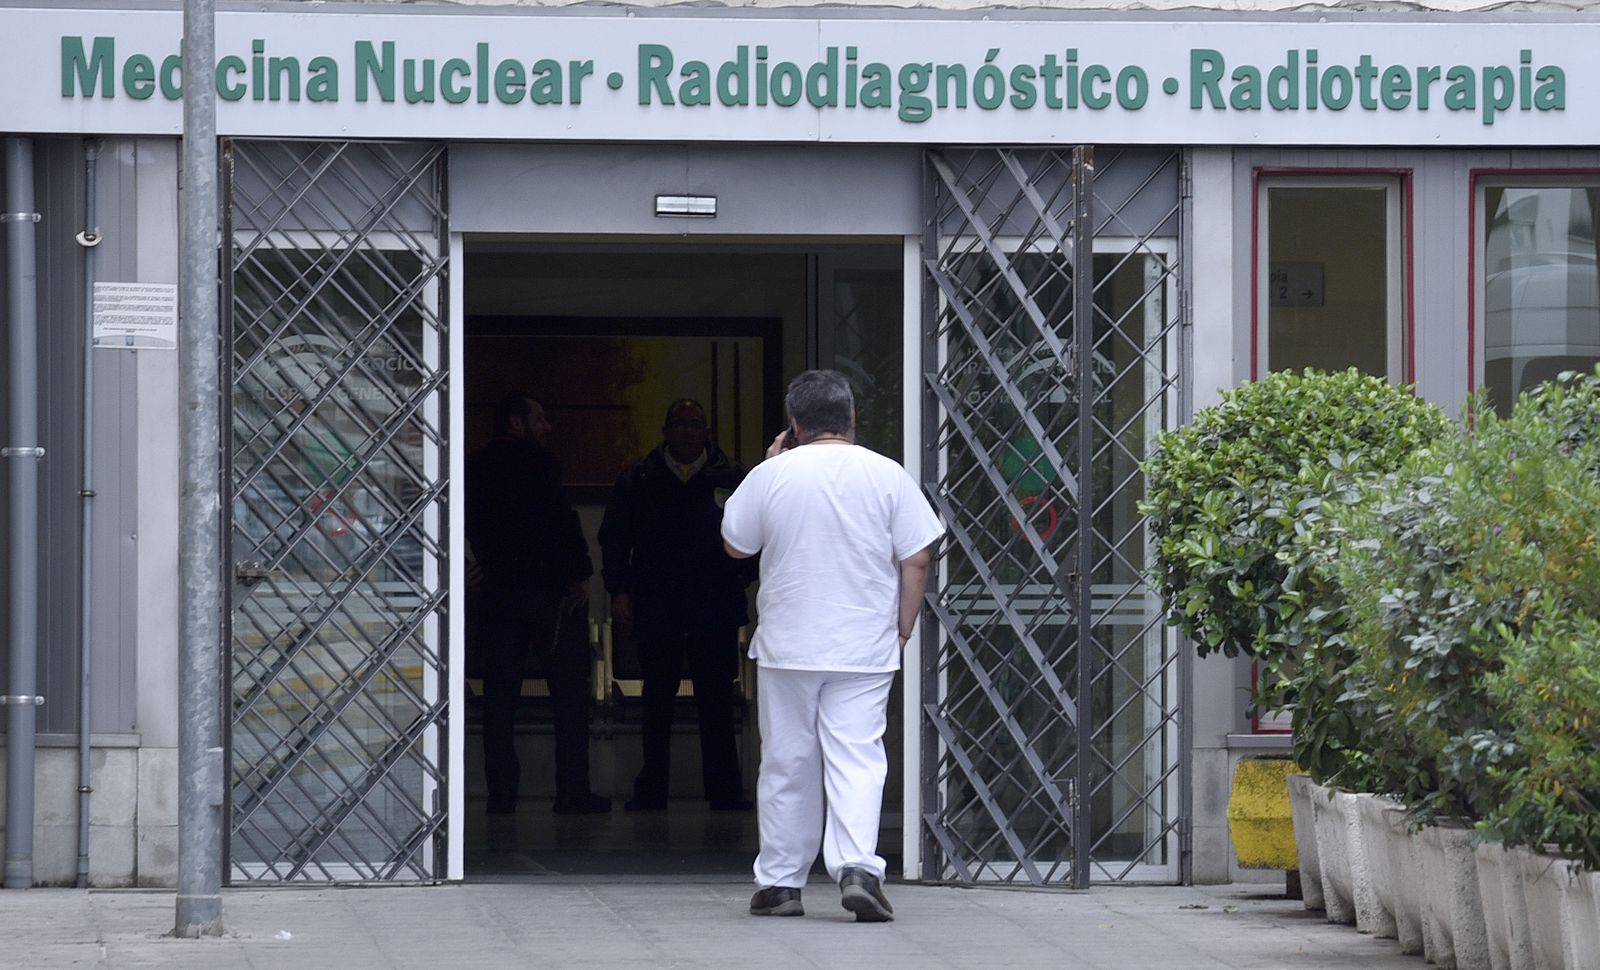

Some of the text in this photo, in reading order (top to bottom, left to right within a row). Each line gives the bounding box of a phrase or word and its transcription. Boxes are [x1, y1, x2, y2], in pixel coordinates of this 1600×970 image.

[62, 37, 1566, 124] Medcina Nuclear Radiodiagnóstico Radioterapia
[1279, 286, 1288, 299] 2
